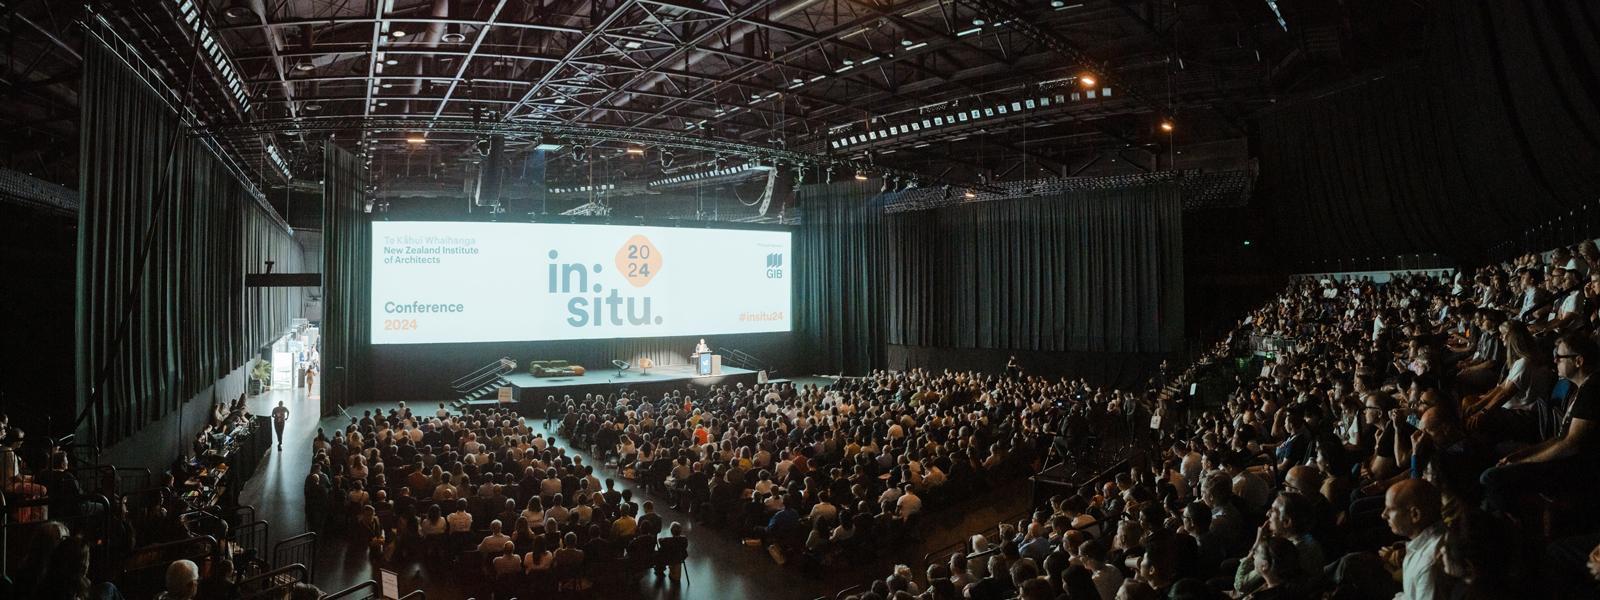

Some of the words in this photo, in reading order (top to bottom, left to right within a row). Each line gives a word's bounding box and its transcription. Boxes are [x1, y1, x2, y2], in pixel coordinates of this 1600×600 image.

[384, 236, 395, 245] Te
[397, 236, 423, 245] Kāhui
[425, 236, 476, 246] Whaihanga
[383, 246, 403, 254] New
[405, 246, 441, 254] Zealand
[442, 246, 479, 254] Institute
[628, 244, 650, 260] 20
[384, 256, 394, 264] of
[395, 256, 441, 264] Architects
[548, 249, 603, 293] in:
[628, 262, 650, 278] 24
[766, 268, 783, 279] GIB
[384, 301, 464, 313] Conference
[567, 288, 663, 328] situ.
[739, 311, 784, 322] #insitu24
[384, 319, 418, 330] 2024
